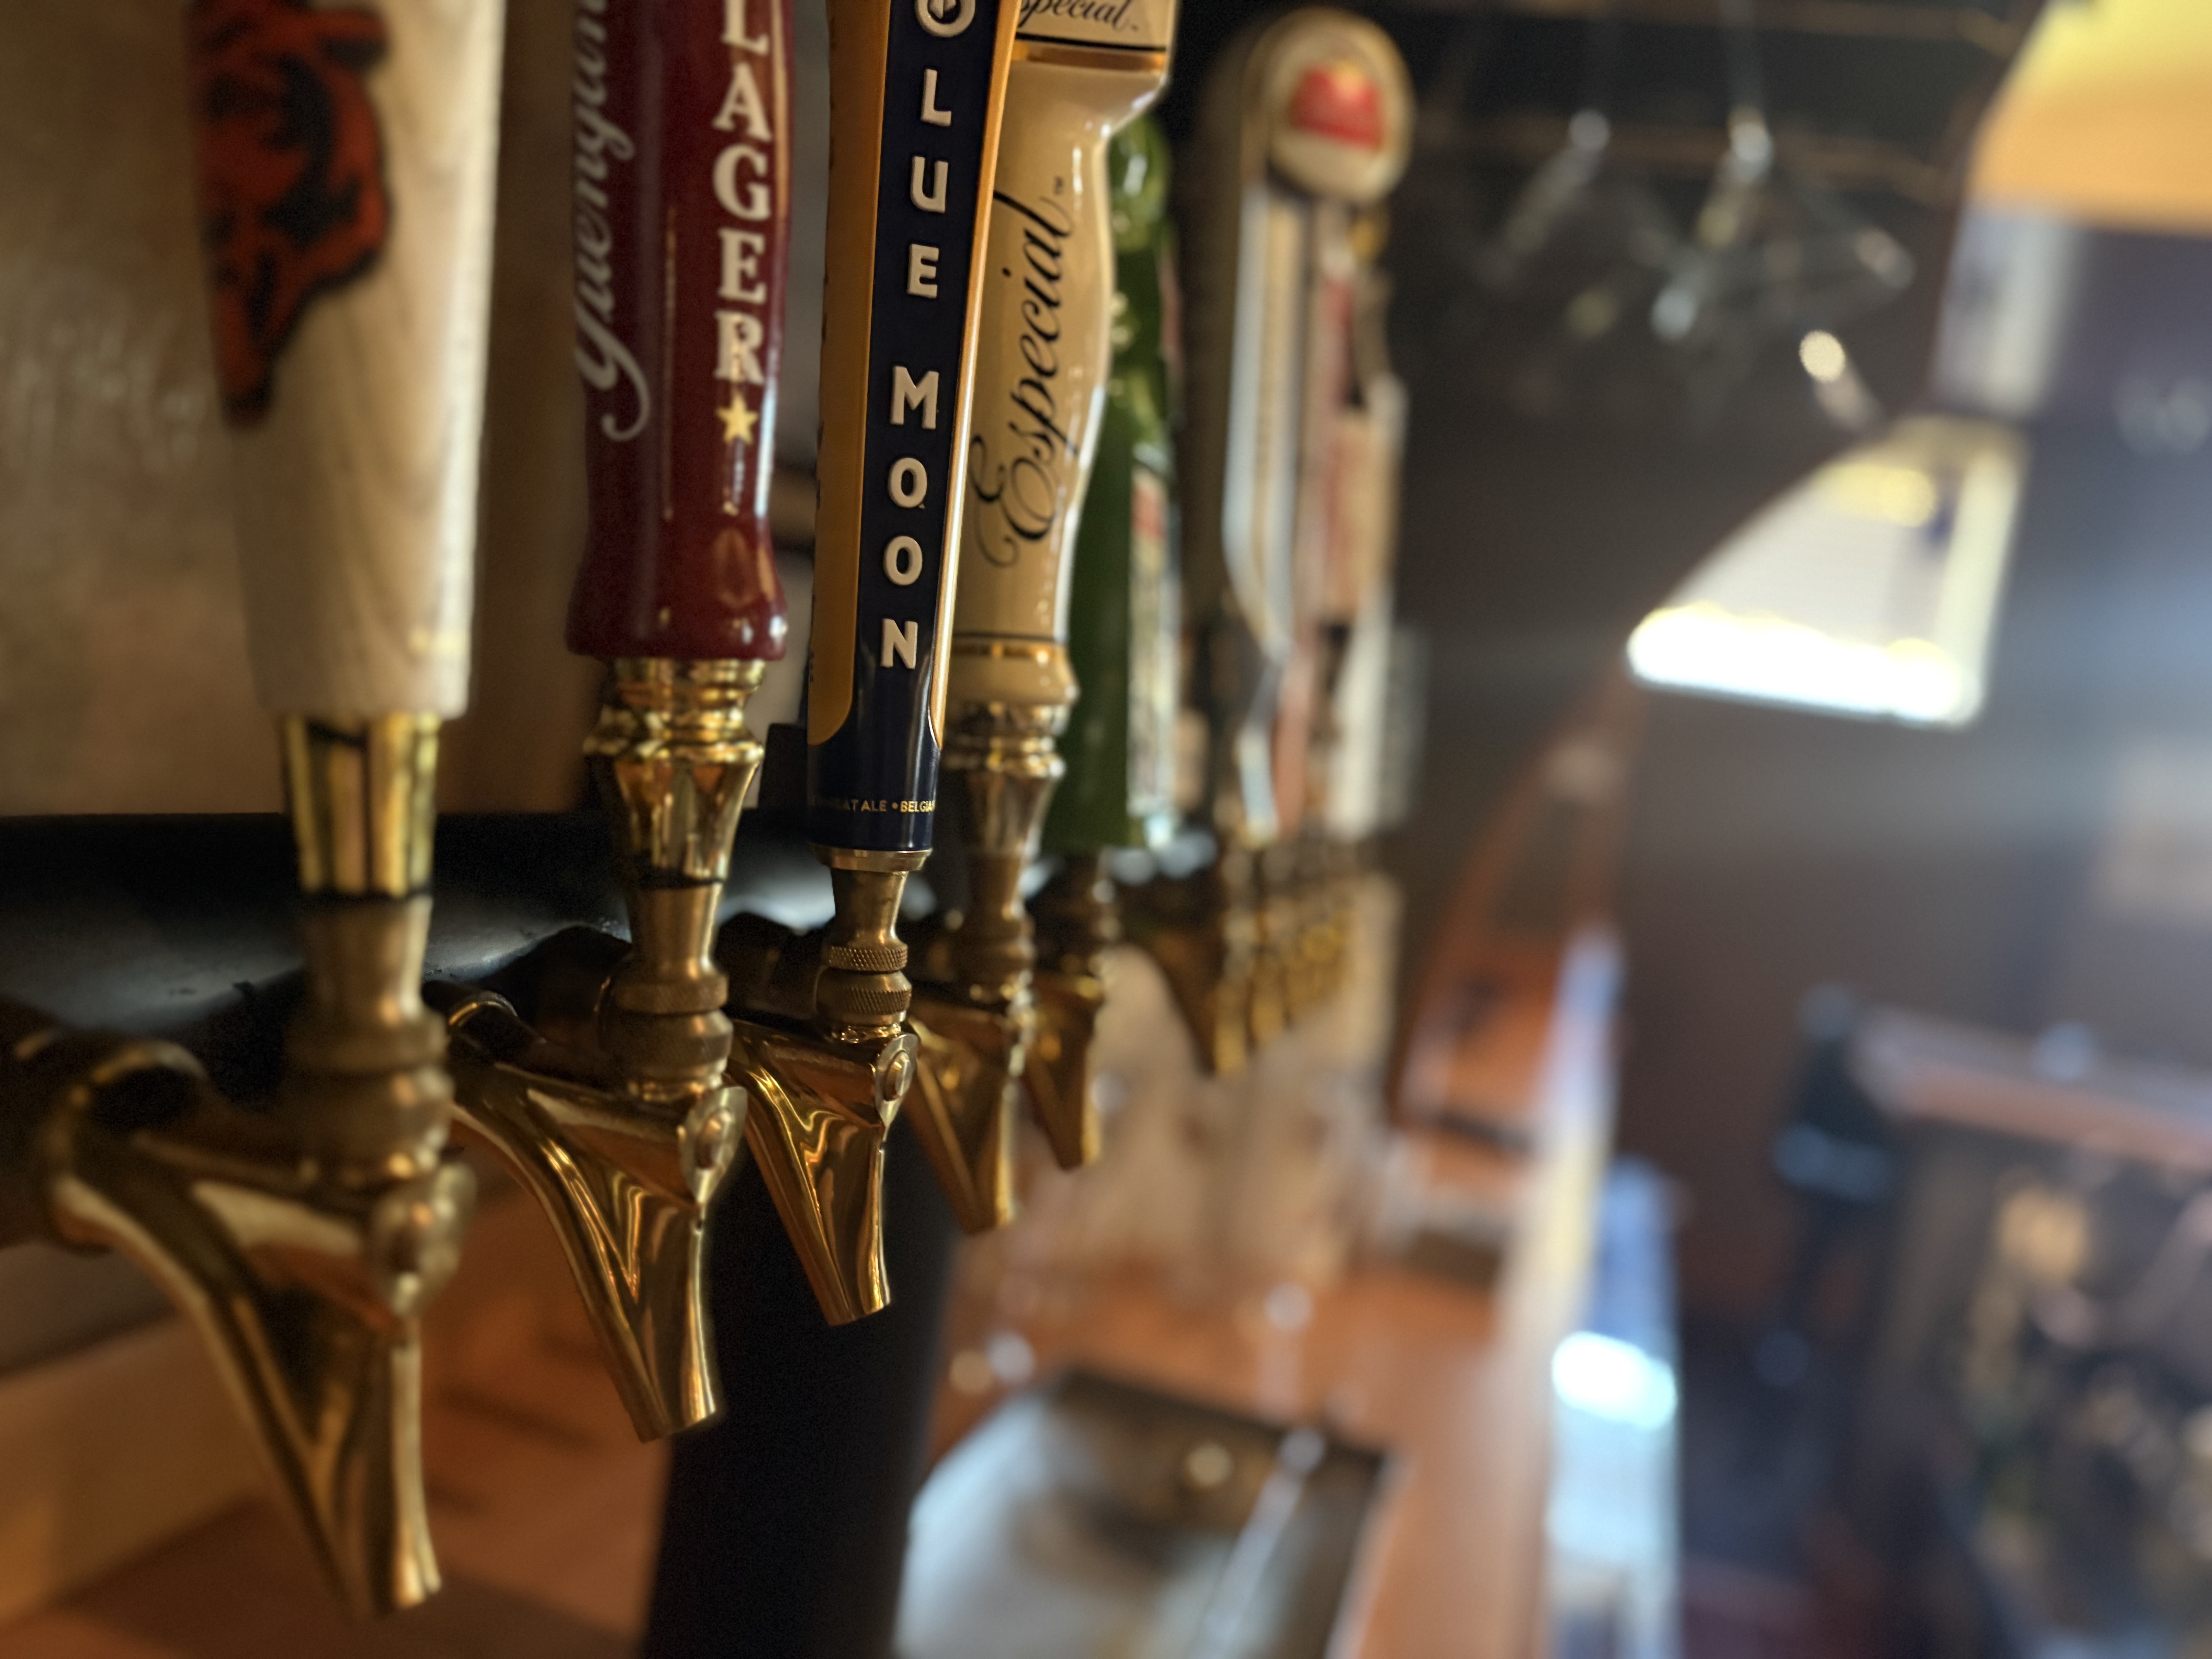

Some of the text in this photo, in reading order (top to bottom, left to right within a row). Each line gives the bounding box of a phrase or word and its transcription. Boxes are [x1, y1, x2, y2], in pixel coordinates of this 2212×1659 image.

[712, 0, 771, 385] LAGER
[880, 366, 939, 670] MOON
[969, 190, 1078, 568] Especial
[861, 800, 887, 812] ALE
